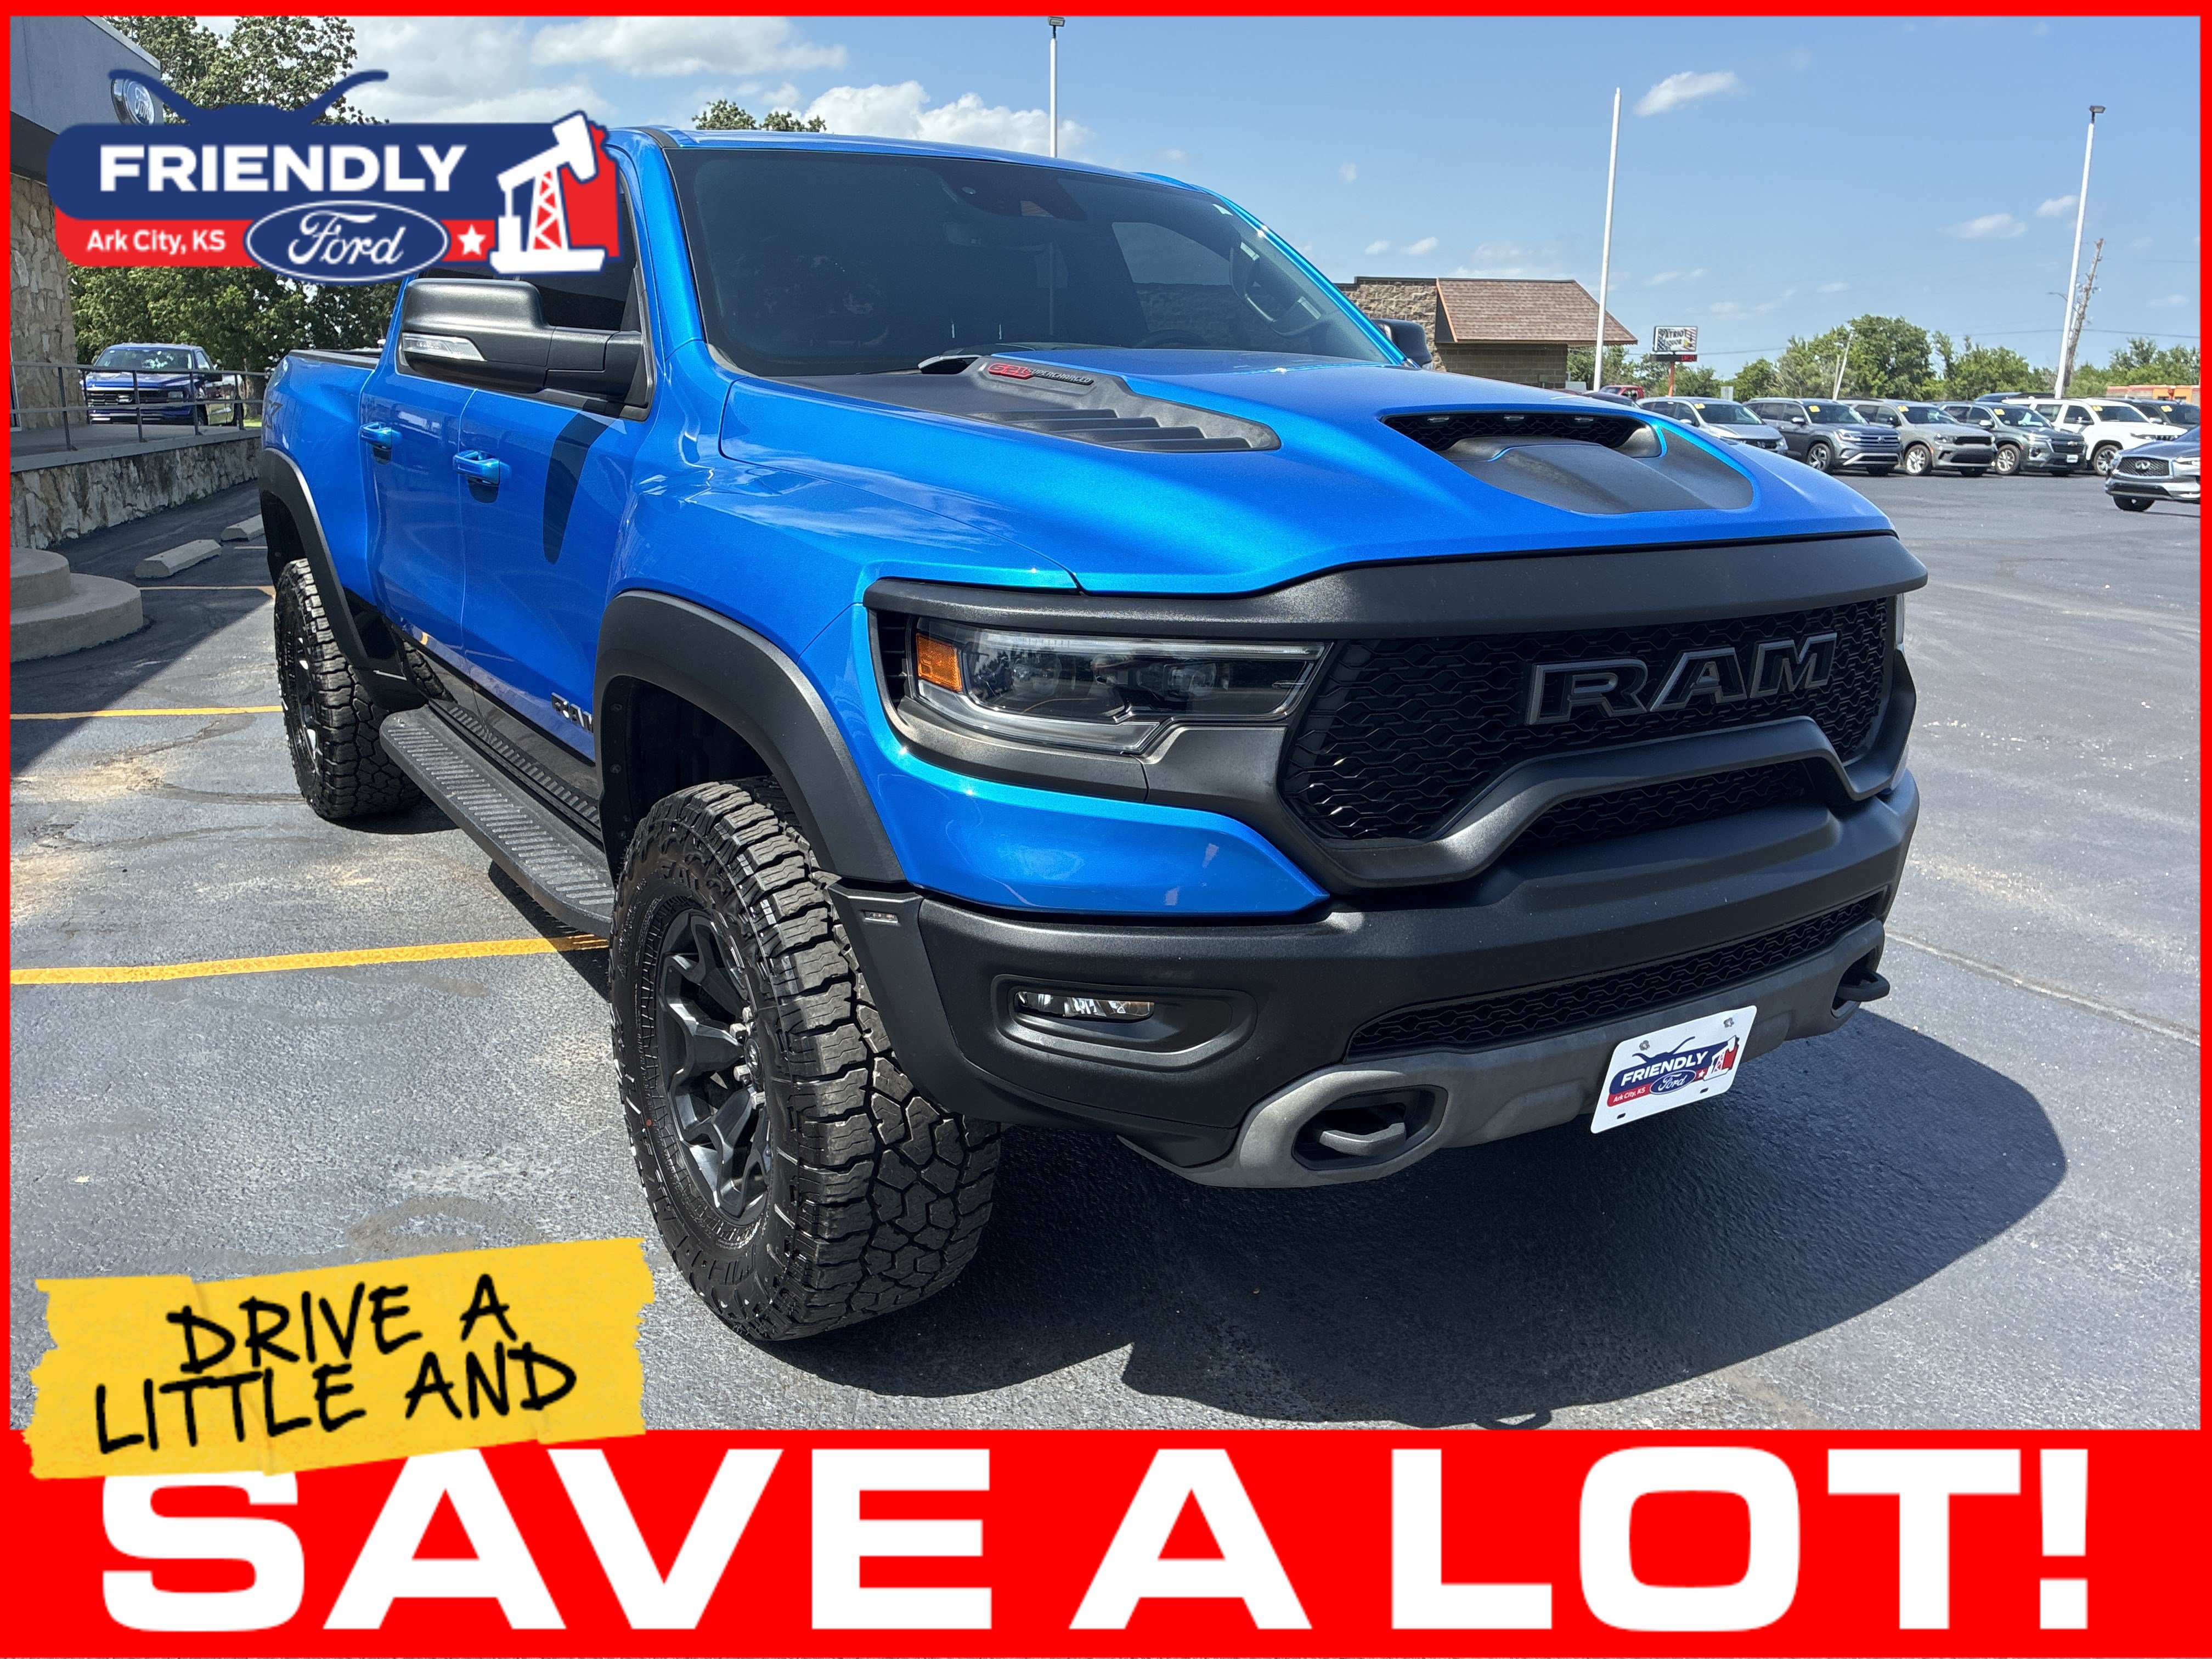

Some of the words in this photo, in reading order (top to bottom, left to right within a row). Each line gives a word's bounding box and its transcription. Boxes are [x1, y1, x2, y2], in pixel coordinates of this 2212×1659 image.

[1027, 368, 1092, 383] SUPERCHARGED
[1526, 633, 1838, 725] RAM
[1620, 1051, 1709, 1087] FRIENDLY
[1657, 1073, 1688, 1092] Ford
[1613, 1095, 1624, 1103] Ark
[1624, 1091, 1637, 1100] City,
